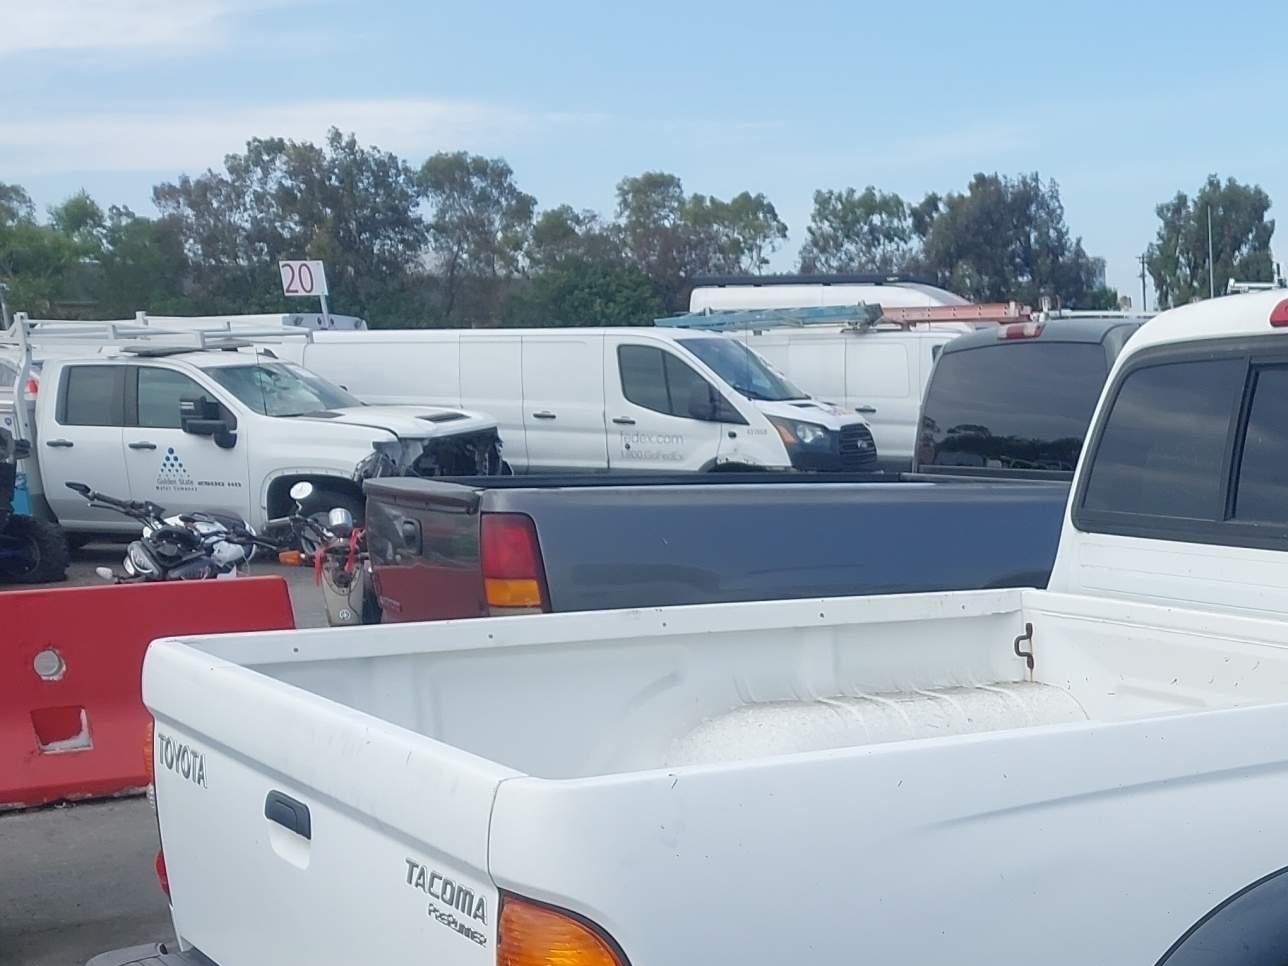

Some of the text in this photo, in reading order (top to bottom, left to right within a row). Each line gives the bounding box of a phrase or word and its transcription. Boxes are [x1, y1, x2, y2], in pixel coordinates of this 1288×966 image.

[281, 263, 314, 294] 20
[158, 733, 208, 790] TOYOTA
[405, 857, 488, 926] TACOMA
